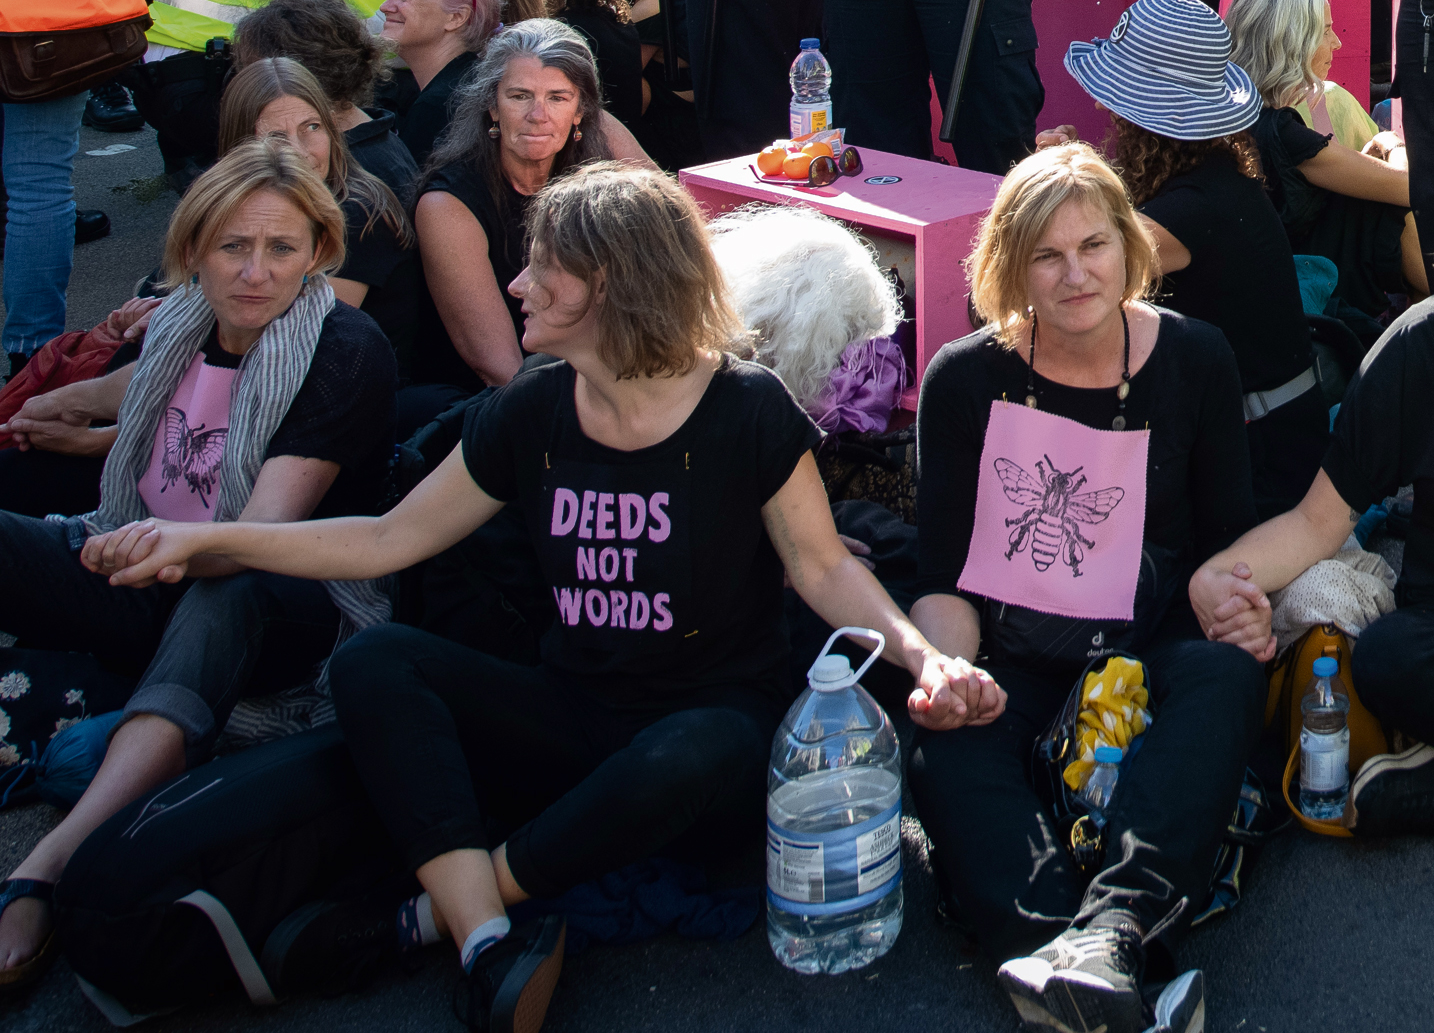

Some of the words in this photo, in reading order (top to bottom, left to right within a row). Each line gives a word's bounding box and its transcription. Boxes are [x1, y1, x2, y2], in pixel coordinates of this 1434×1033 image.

[551, 487, 671, 543] DEEDS
[577, 546, 638, 583] NOT
[553, 585, 674, 632] WORDS
[872, 824, 892, 840] TESCO
